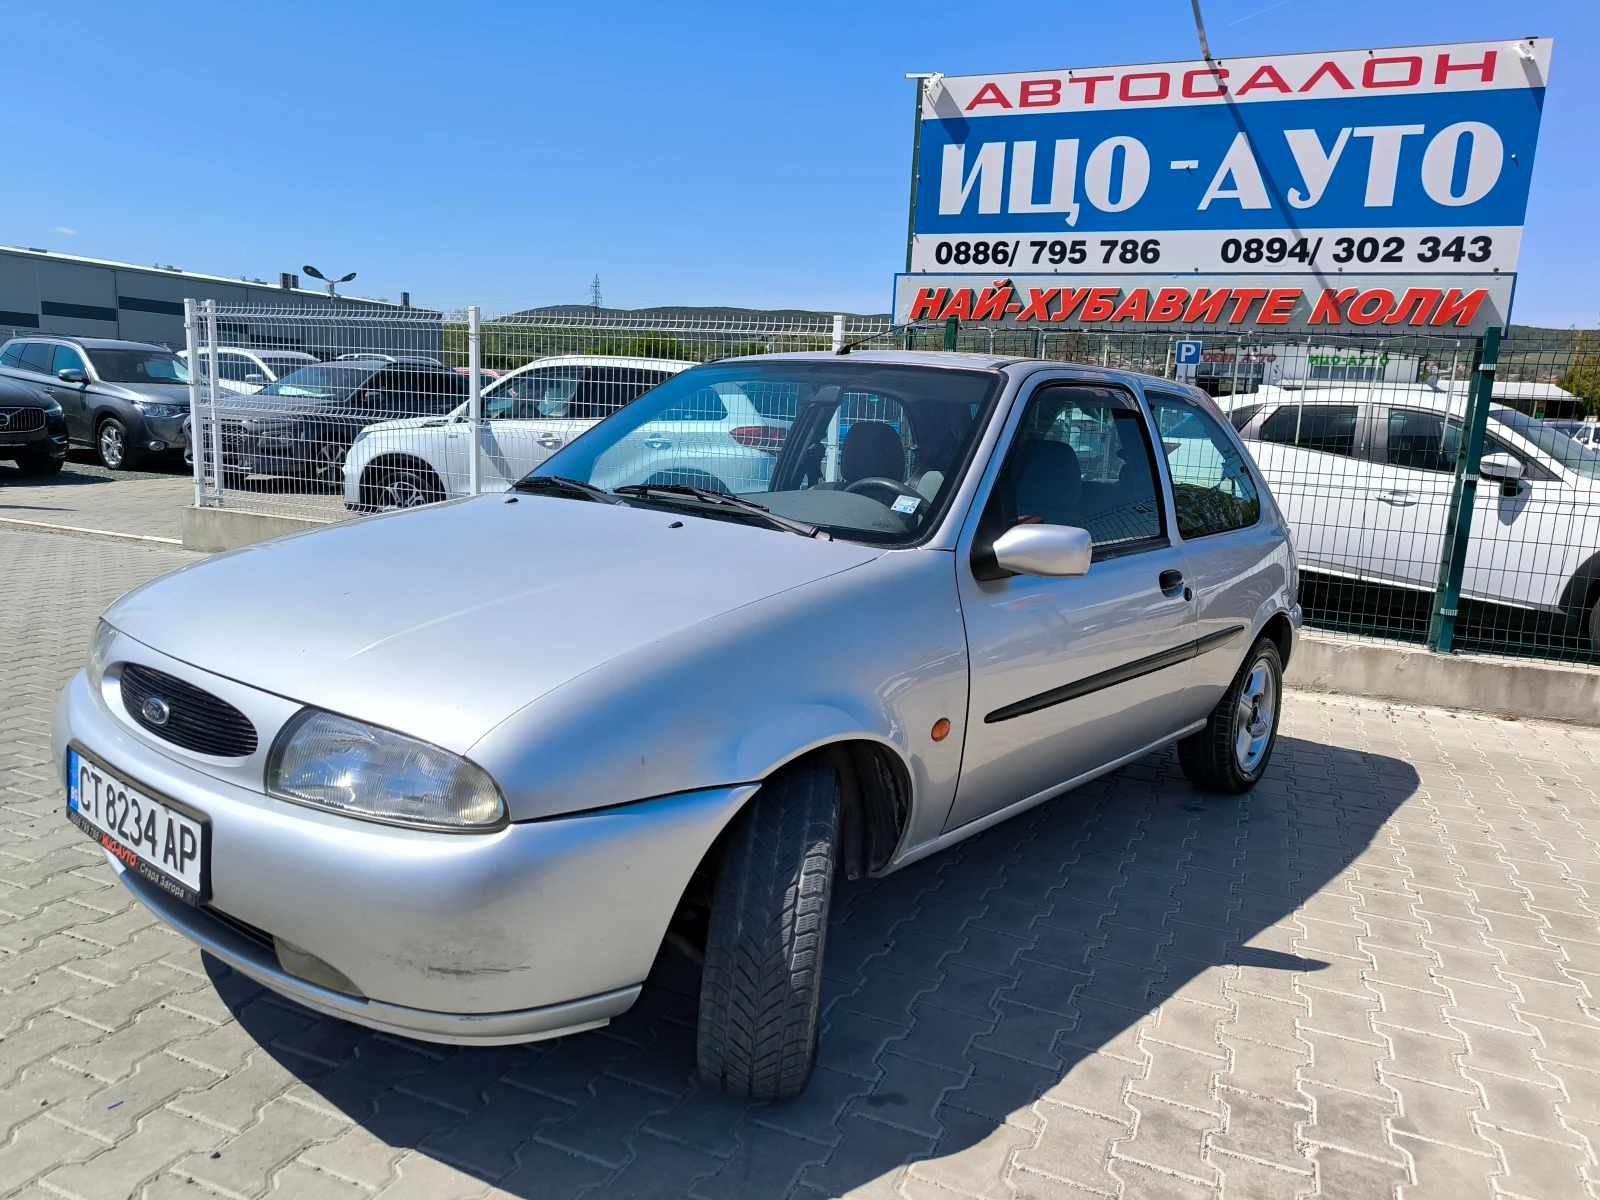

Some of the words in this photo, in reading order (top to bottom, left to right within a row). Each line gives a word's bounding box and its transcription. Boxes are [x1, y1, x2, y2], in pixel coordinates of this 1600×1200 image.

[965, 51, 1498, 111] АВТОСАЛОН
[935, 240, 1020, 267] 0886/
[1029, 240, 1087, 265] 795
[1100, 239, 1161, 265] 786
[1220, 237, 1323, 266] 0894/
[1332, 237, 1405, 263] 302
[1417, 235, 1493, 263] 343
[909, 278, 1303, 324] НАЙ-ХУБАВИТЕ
[1307, 287, 1489, 327] КОЛИ
[1180, 343, 1196, 362] P
[146, 701, 161, 718] Ford
[106, 783, 158, 858] 8234
[139, 862, 159, 883] Стара
[160, 875, 185, 899] Загора
